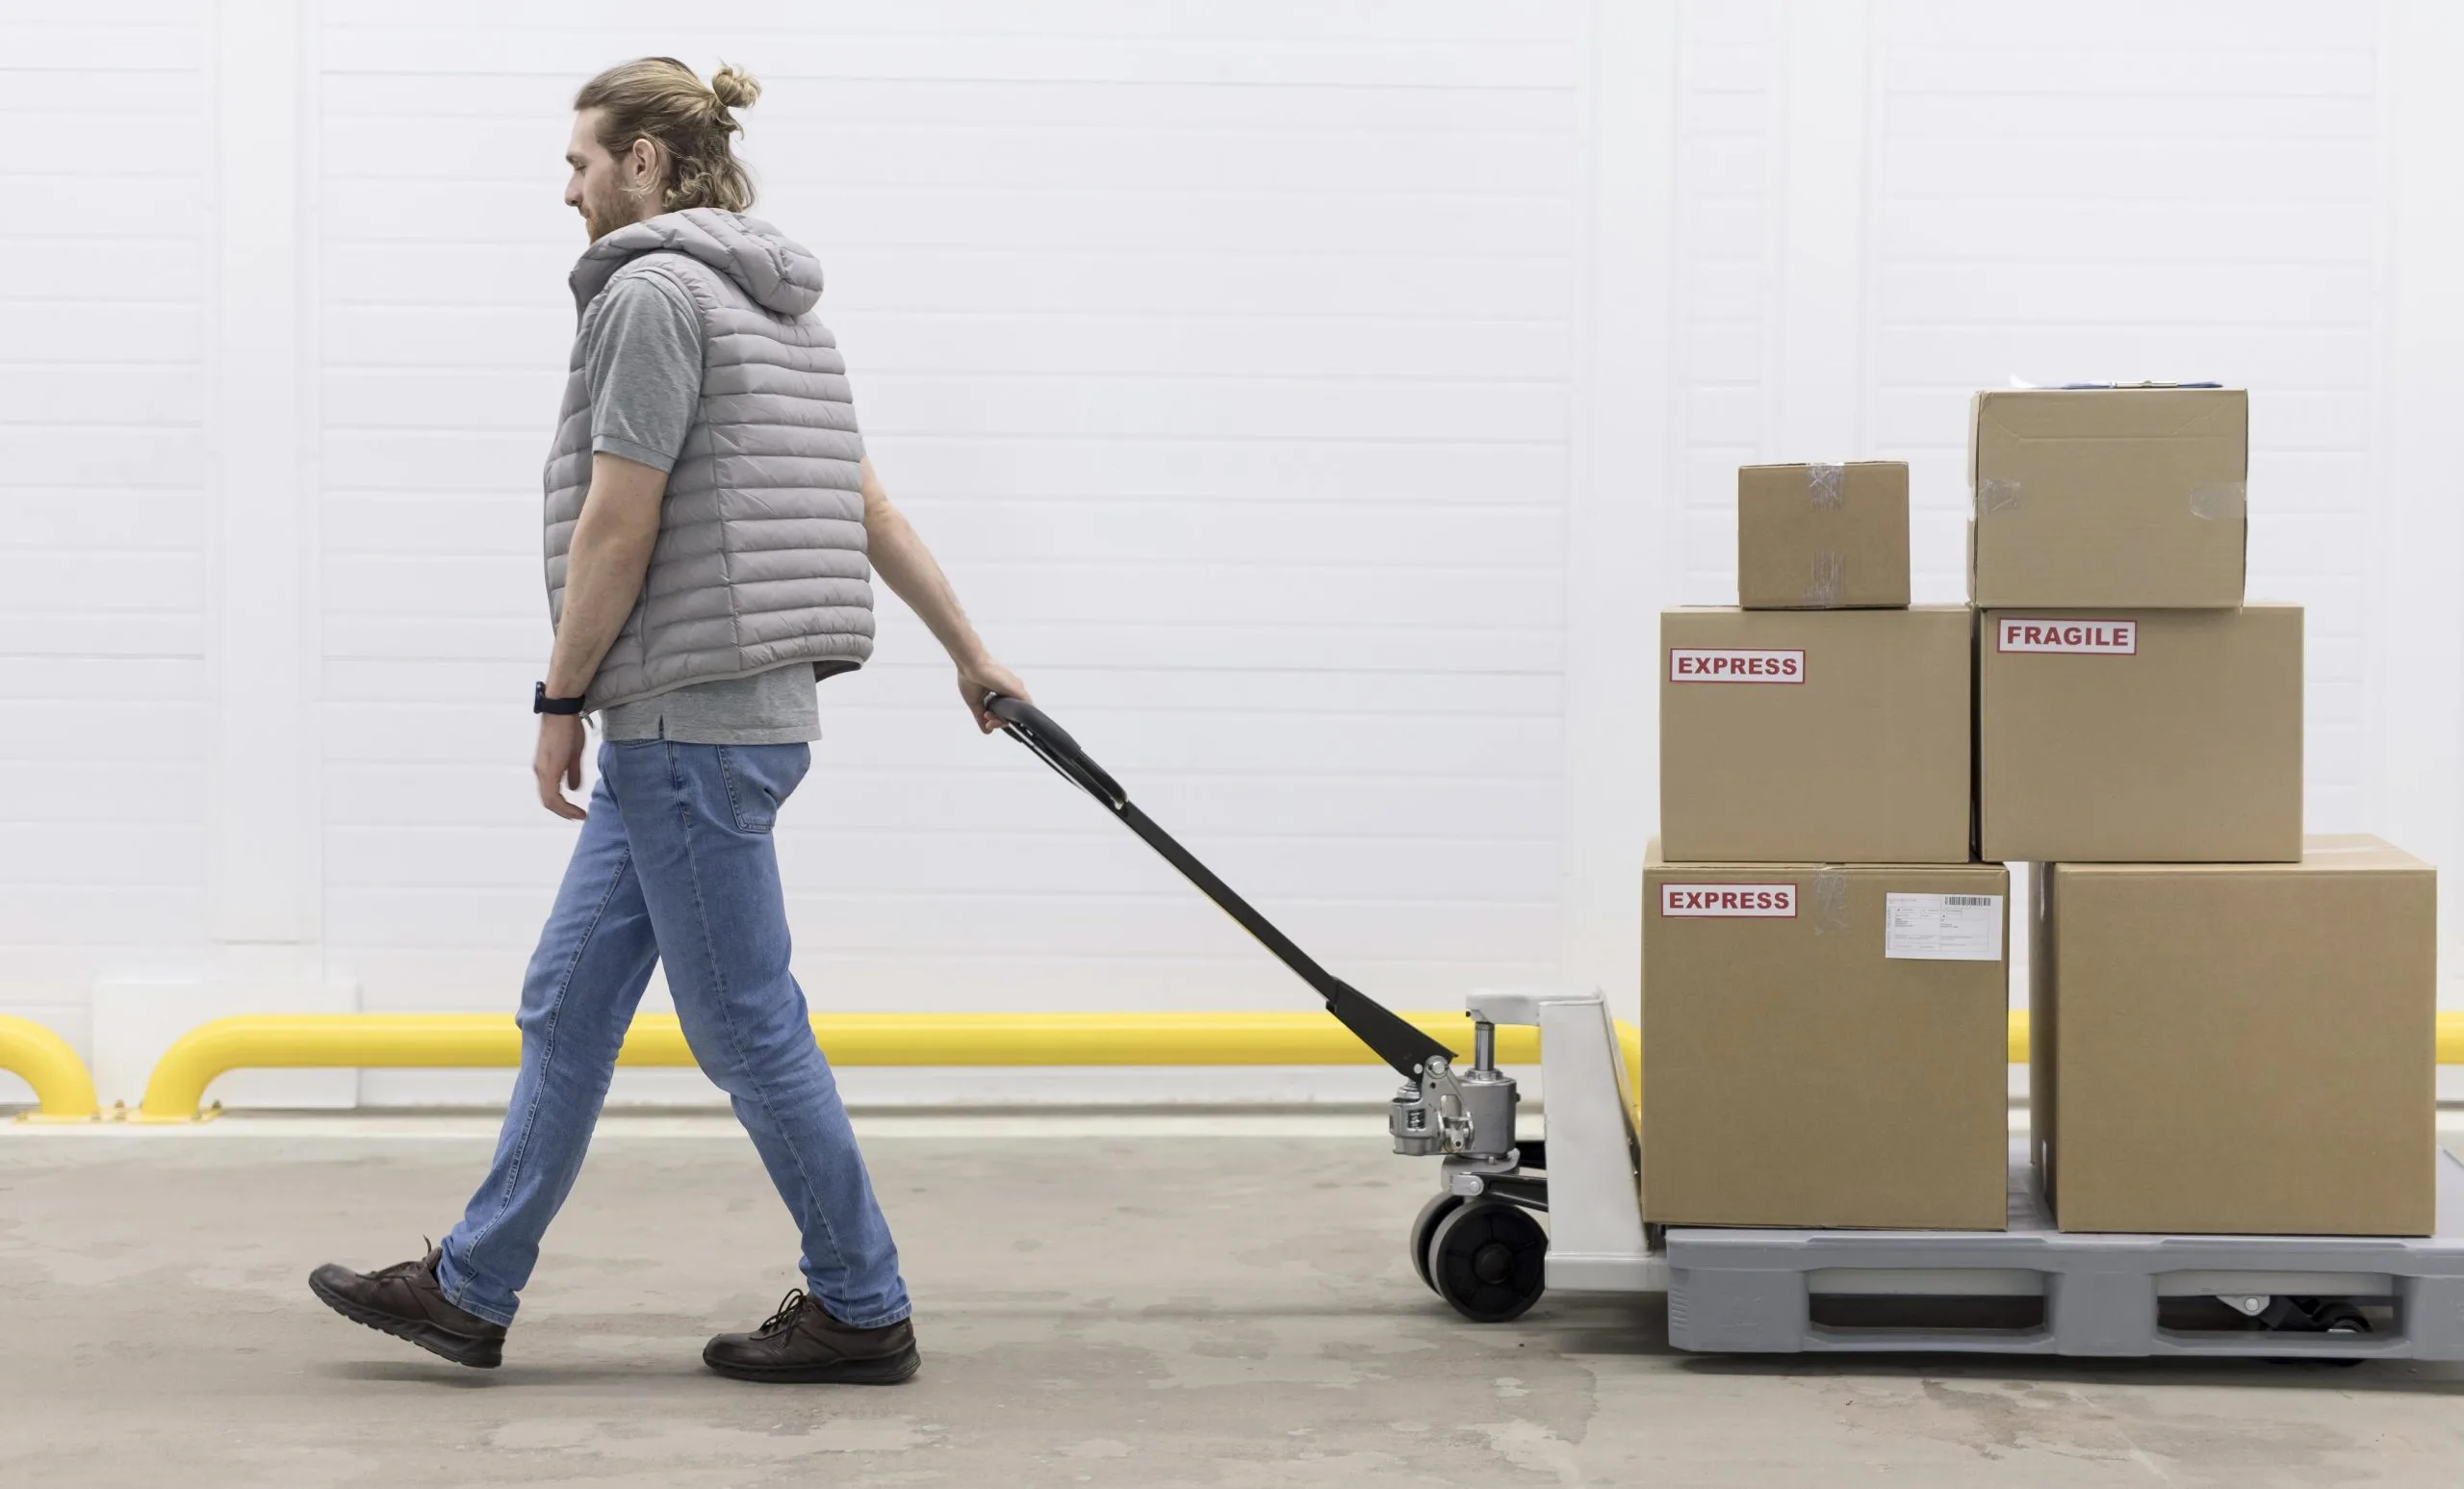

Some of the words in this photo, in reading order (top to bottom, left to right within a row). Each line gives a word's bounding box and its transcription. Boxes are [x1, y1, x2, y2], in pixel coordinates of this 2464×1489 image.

[2007, 626, 2129, 647] FRAGILE
[1678, 657, 1798, 676] EXPRESS
[1669, 891, 1789, 910] EXPRESS
